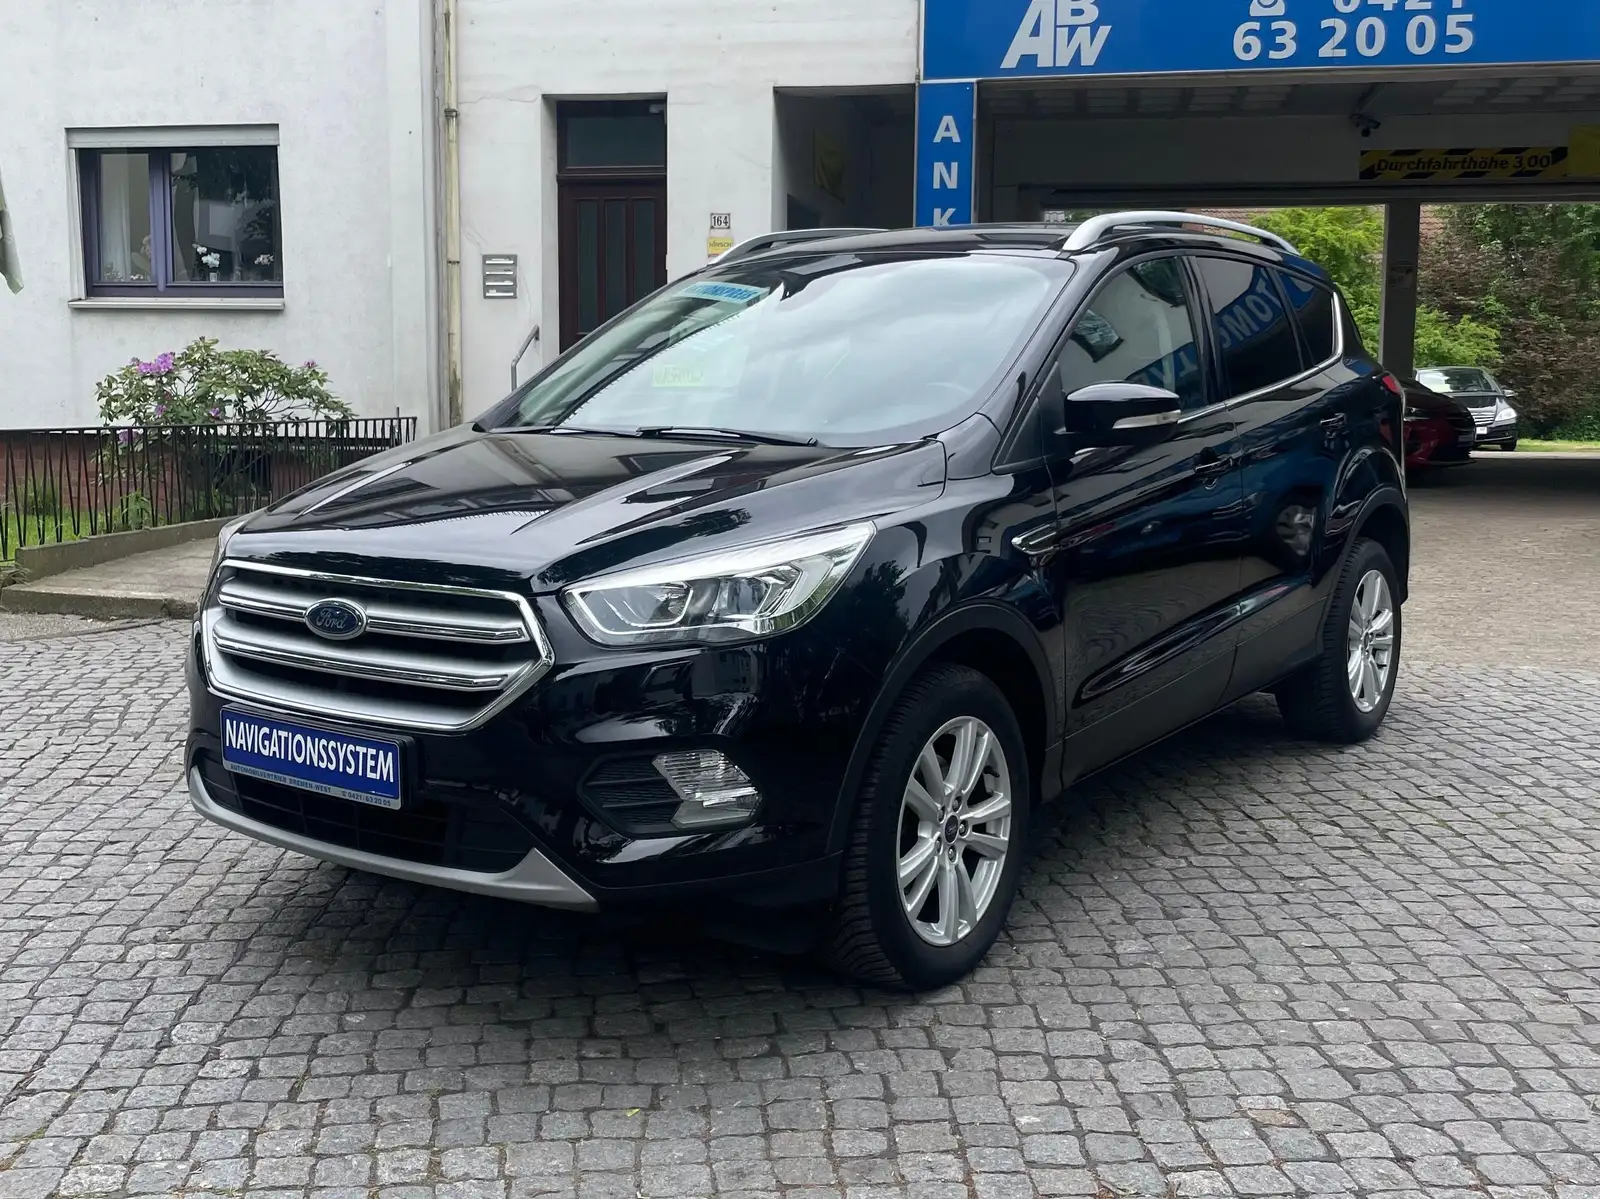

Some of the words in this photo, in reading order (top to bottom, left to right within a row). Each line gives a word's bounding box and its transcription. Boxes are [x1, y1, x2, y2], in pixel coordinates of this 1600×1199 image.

[1233, 21, 1297, 60] 63
[1318, 17, 1386, 57] 20
[1405, 14, 1474, 55] 05
[1376, 156, 1509, 172] Durchfahrthöhe
[713, 216, 728, 227] 164
[316, 608, 348, 629] Ford
[225, 718, 394, 783] NAVIGATIONSSYSTEM
[289, 779, 332, 793] BREMEN-WEST
